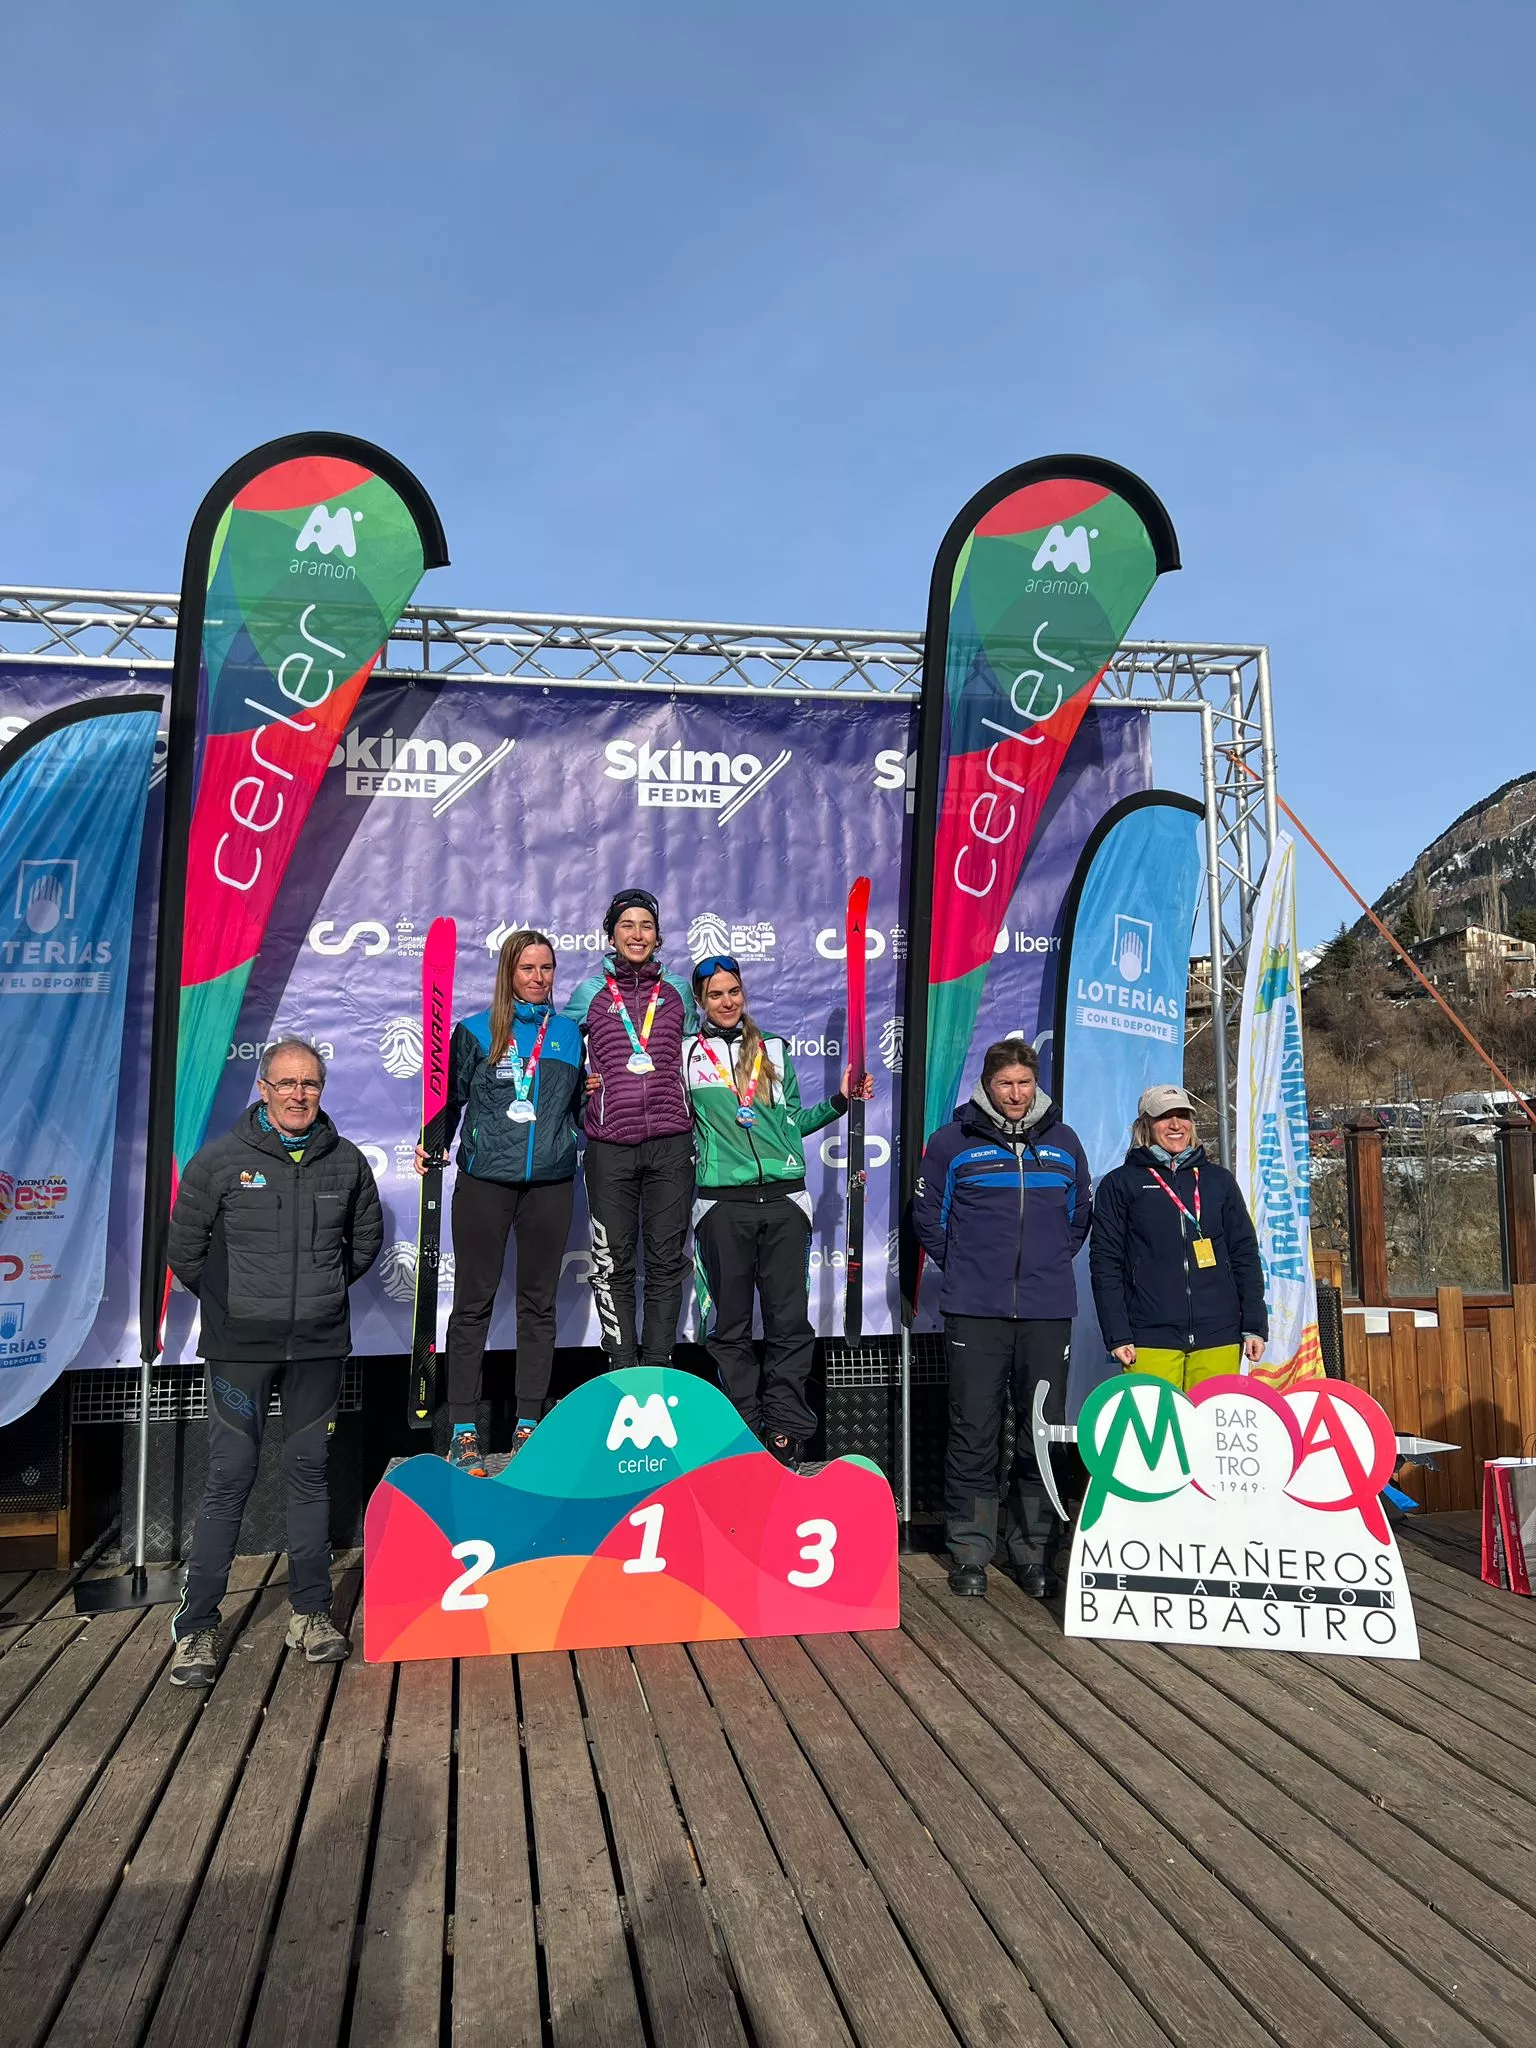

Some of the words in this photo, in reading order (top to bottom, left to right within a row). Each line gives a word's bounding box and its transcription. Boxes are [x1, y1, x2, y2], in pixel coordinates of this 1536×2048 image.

[289, 558, 357, 581] aramon
[1024, 576, 1090, 596] aramon
[214, 603, 347, 891] cerler
[953, 620, 1076, 898] cerler
[356, 775, 437, 794] FEDME
[647, 787, 722, 804] FEDME
[11, 977, 26, 988] EL
[32, 976, 94, 988] DEPORTE
[1077, 977, 1179, 1019] LOTERÍAS
[1087, 1012, 1109, 1024] CON
[1111, 1016, 1121, 1026] EL
[1123, 1019, 1168, 1037] DEPORTE
[430, 982, 446, 1098] DYNAFIT
[1215, 1408, 1258, 1429] BAR
[1216, 1431, 1259, 1453] BAS
[618, 1454, 668, 1474] cerler
[1215, 1455, 1261, 1477] TRO
[622, 1502, 667, 1575] 1
[786, 1517, 839, 1589] 3
[1080, 1538, 1394, 1586] MONTAÑEROS
[440, 1539, 497, 1612] 2
[1081, 1572, 1128, 1590] DE
[1080, 1590, 1397, 1645] BARBASTRO
